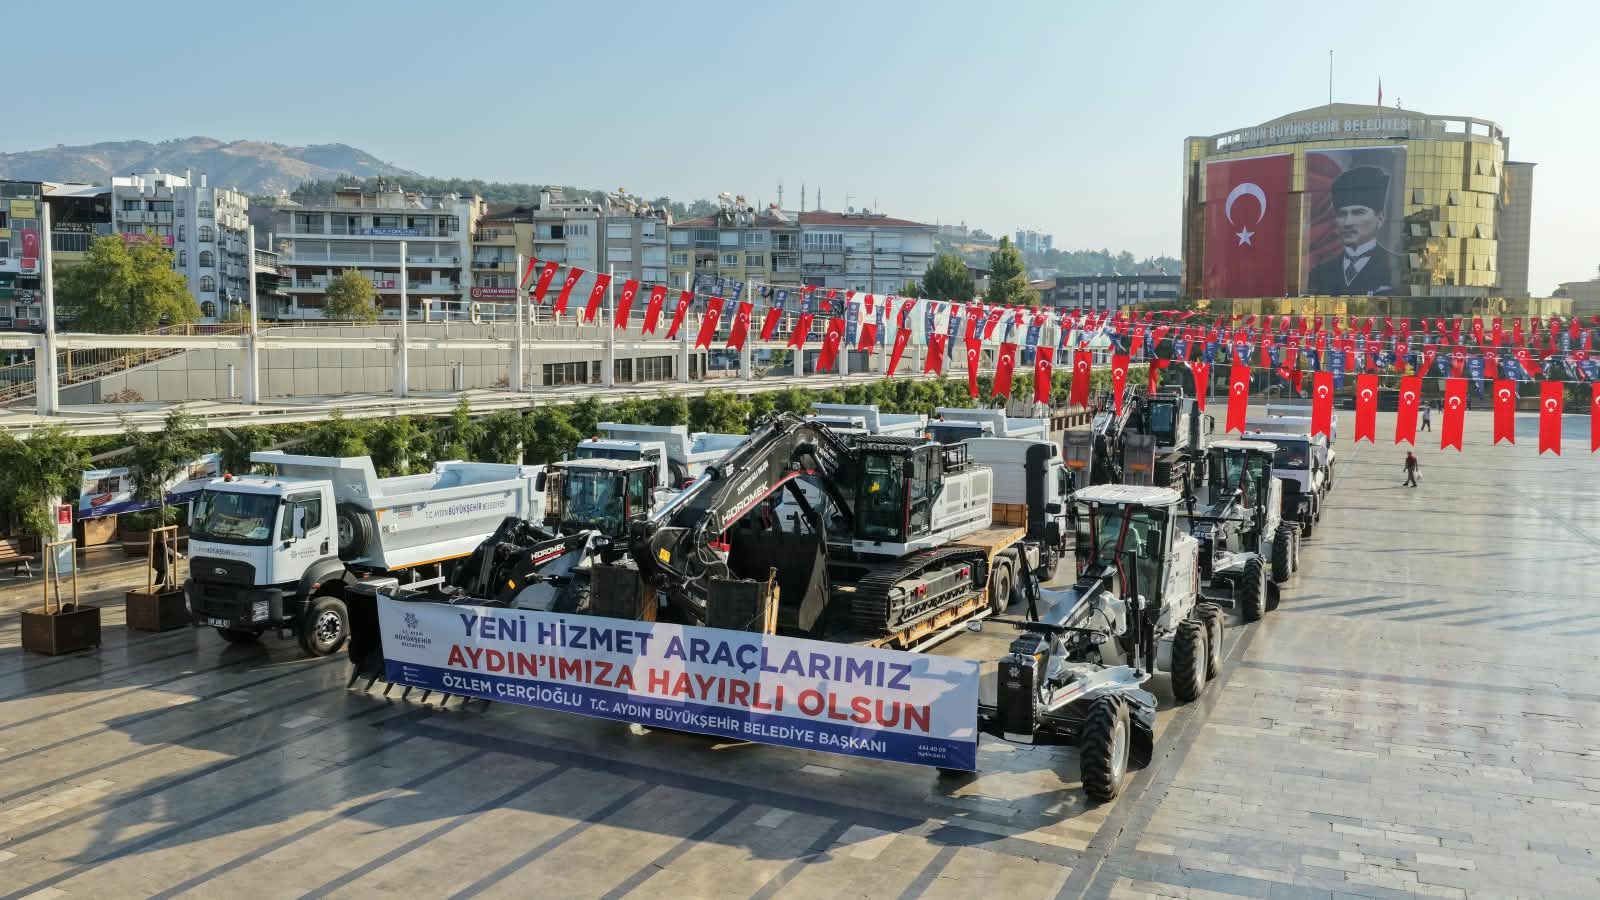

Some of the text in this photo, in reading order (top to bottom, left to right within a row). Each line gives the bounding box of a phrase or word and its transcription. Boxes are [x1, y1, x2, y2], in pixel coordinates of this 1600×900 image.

[460, 613, 912, 691] YENİ HİZMET ARAÇLARIMIZ
[442, 672, 886, 753] ÖZLEM ÇERÇİOĞLU T.C. AYDIN BÜYÜKŞEHİR BELEDİYE BAŞKANI
[647, 669, 784, 712] HAYIRLI
[797, 688, 931, 733] OLSUN
